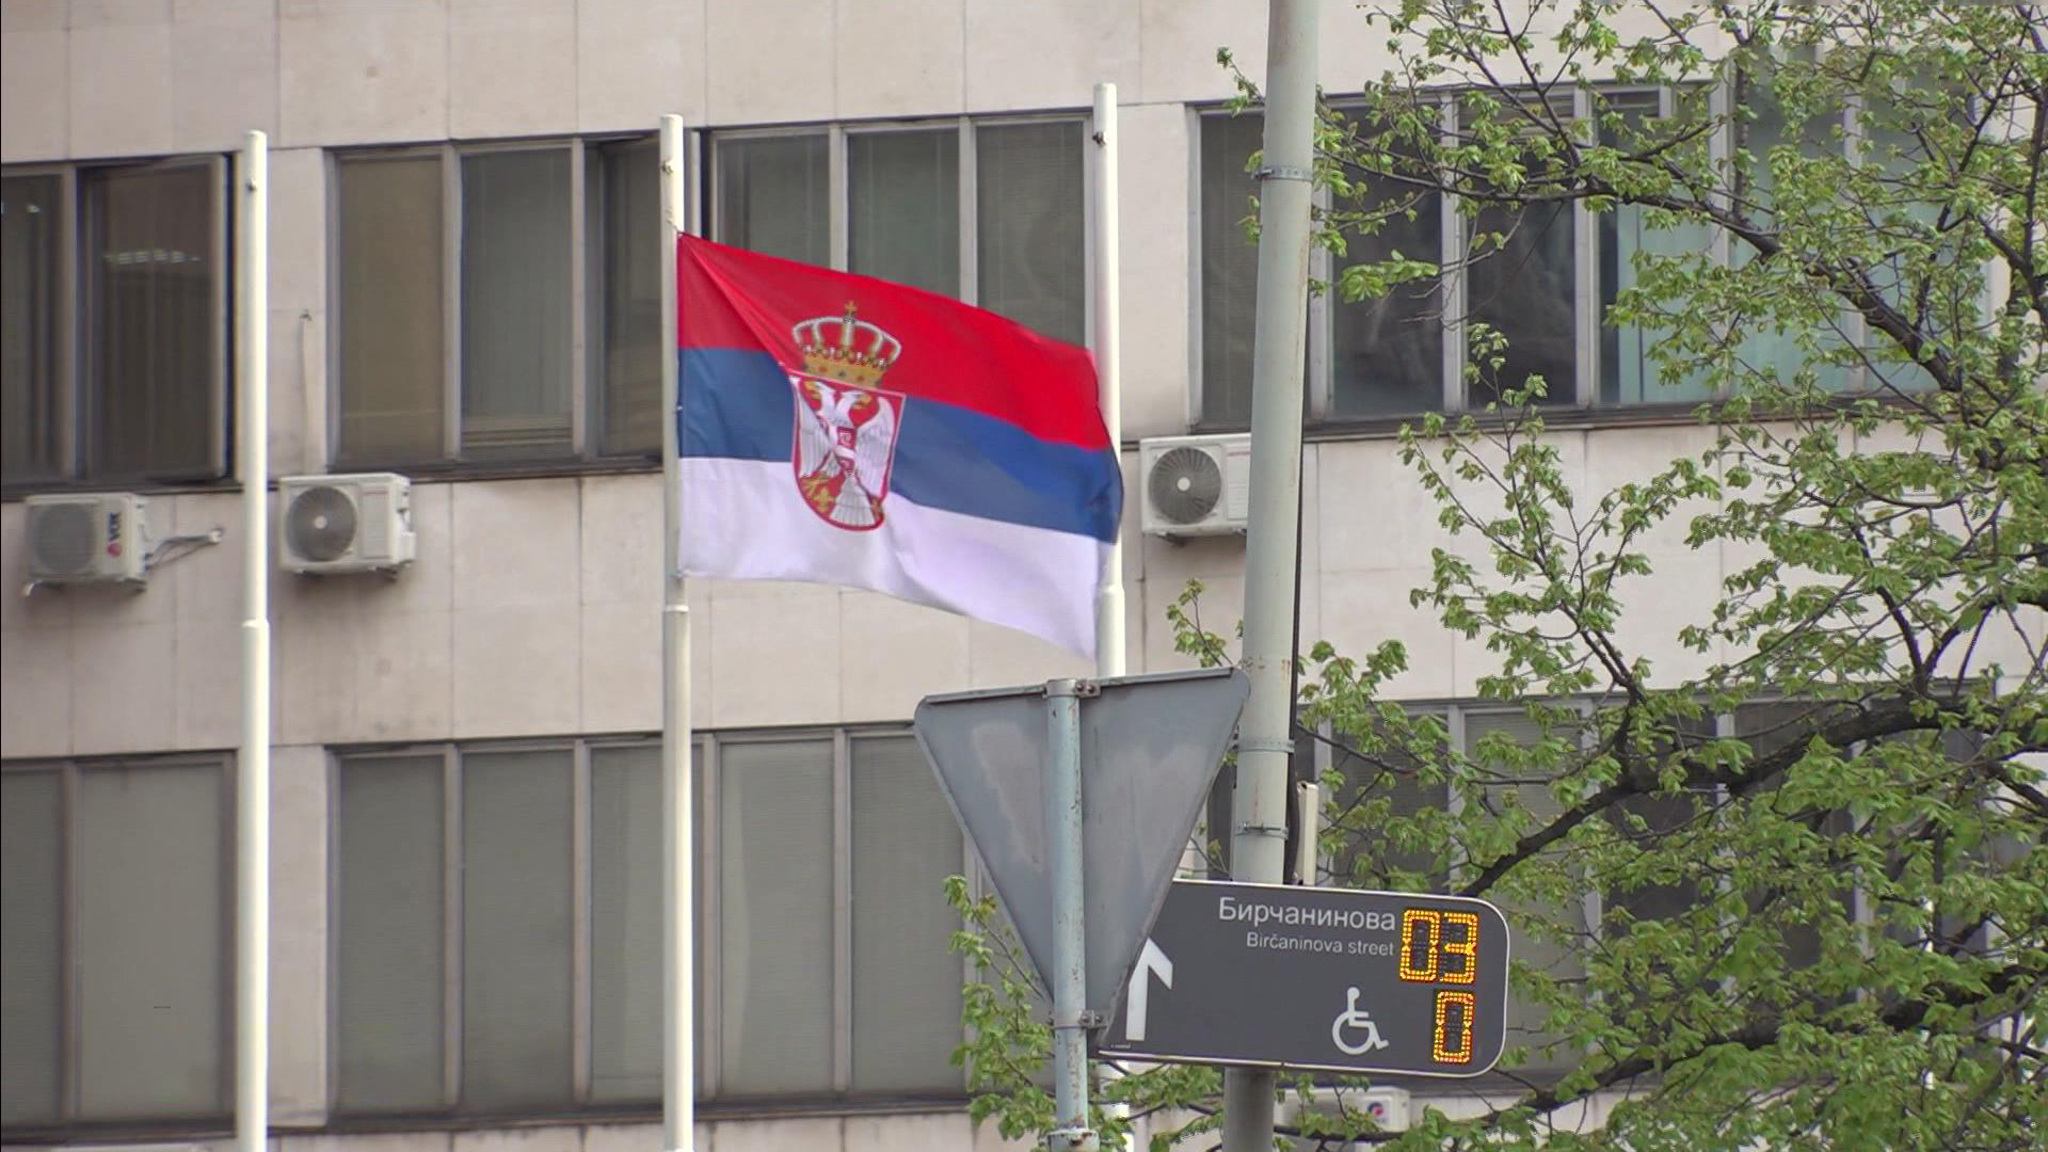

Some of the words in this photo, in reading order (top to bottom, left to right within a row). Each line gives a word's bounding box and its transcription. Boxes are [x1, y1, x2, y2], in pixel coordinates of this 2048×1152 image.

[1218, 895, 1396, 931] Бирчанинова
[1246, 931, 1343, 954] Birčaninova
[1347, 939, 1395, 957] street
[1400, 908, 1479, 984] 03
